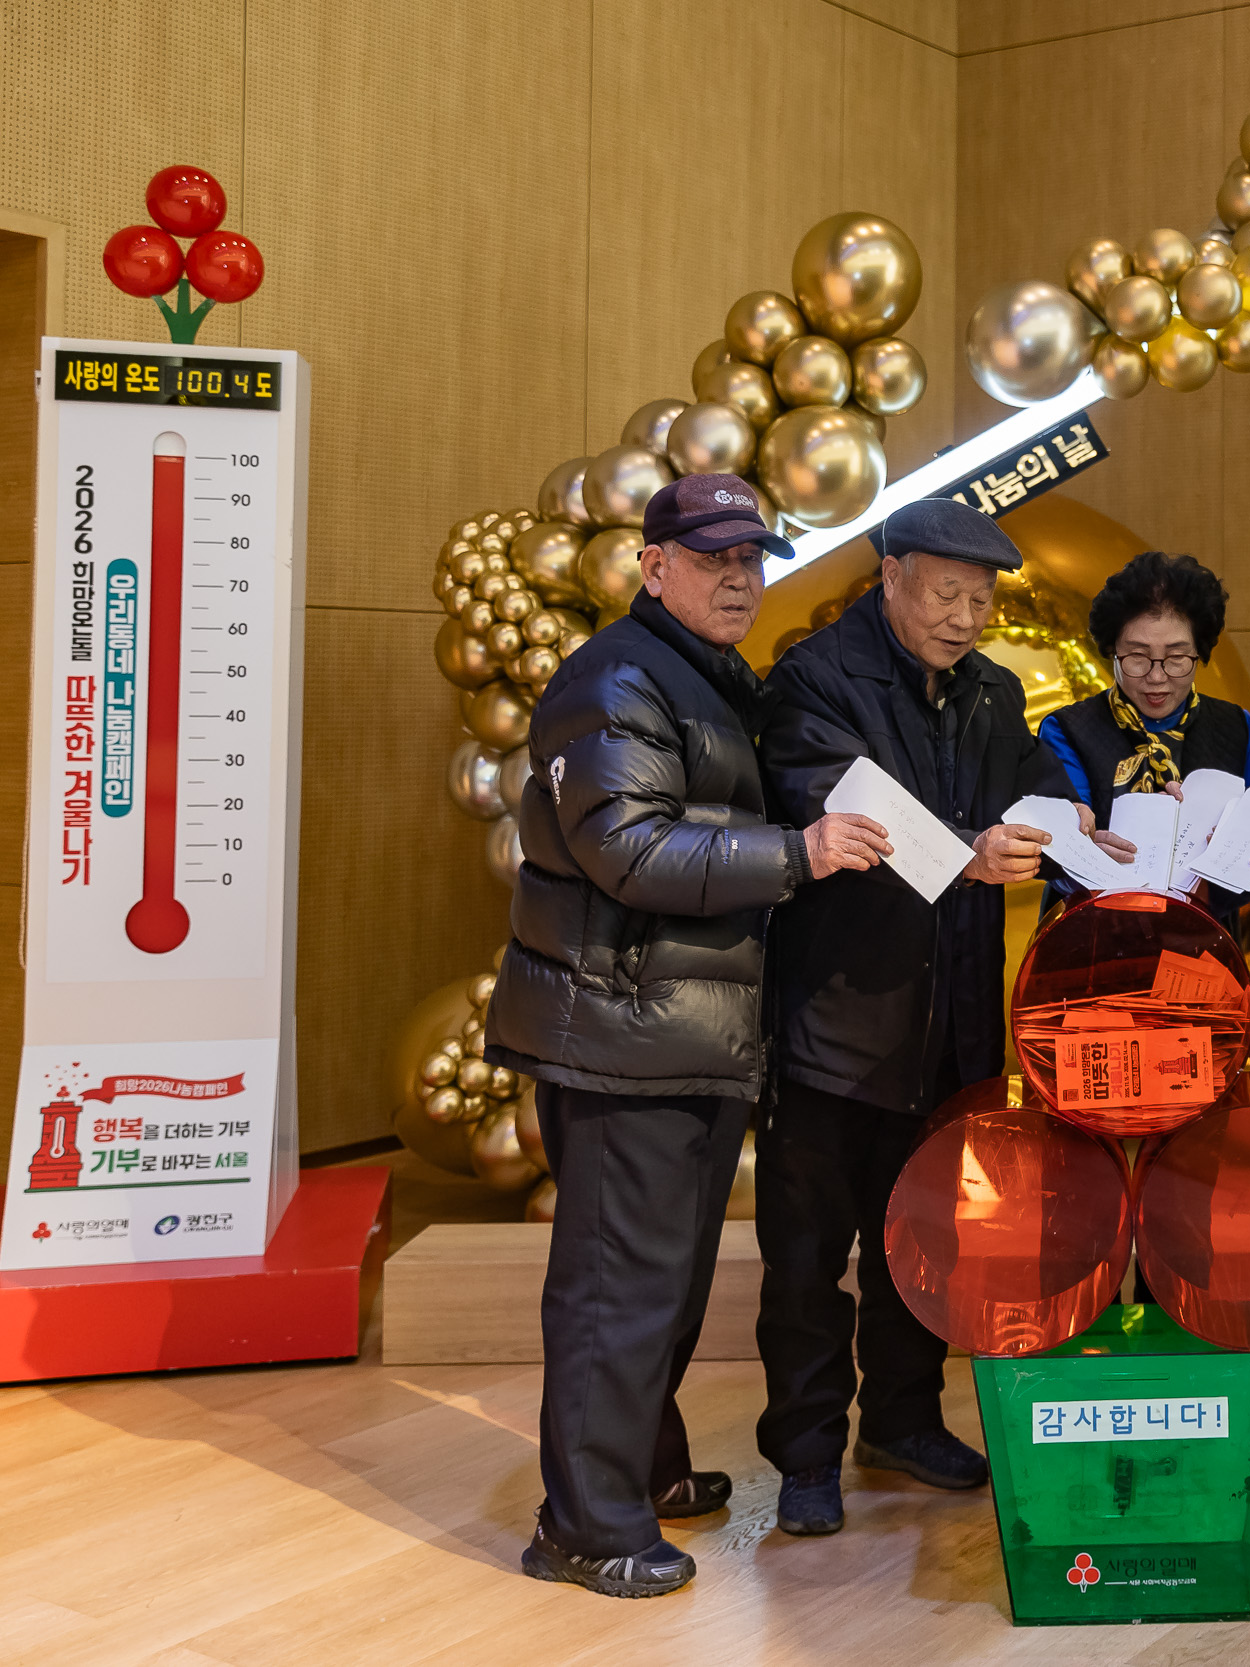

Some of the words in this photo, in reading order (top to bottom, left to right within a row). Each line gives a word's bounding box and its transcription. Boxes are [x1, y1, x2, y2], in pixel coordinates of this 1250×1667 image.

[65, 360, 118, 392] 사랑의
[124, 363, 160, 392] 온도
[1051, 423, 1098, 468] 날
[230, 453, 260, 468] 100
[74, 464, 95, 554] 2026
[230, 493, 251, 507] 90
[230, 536, 250, 550] 80
[229, 579, 249, 593] 70
[71, 561, 95, 661] 희망온돌
[107, 574, 136, 674] 우리동네
[228, 622, 248, 636] 60
[227, 665, 247, 679] 50
[65, 675, 97, 761] 따뜻한
[226, 709, 246, 723] 40
[104, 680, 134, 806] 나눔캠페인
[225, 753, 245, 767] 30
[224, 797, 244, 811] 20
[62, 770, 93, 885] 겨울나기
[223, 838, 243, 851] 10
[222, 873, 233, 887] 0
[1091, 1041, 1109, 1100] 따뜻한
[1109, 1042, 1123, 1099] 겨울나기
[1083, 1079, 1092, 1100] 2026
[93, 1117, 160, 1142] 행복을
[164, 1122, 214, 1140] 더하는
[218, 1120, 251, 1137] 기부
[90, 1148, 157, 1173] 기부로
[162, 1153, 212, 1171] 바꾸는
[214, 1151, 249, 1169] 서울
[187, 1213, 234, 1227] 광진구
[1037, 1402, 1222, 1437] 감사합니다!
